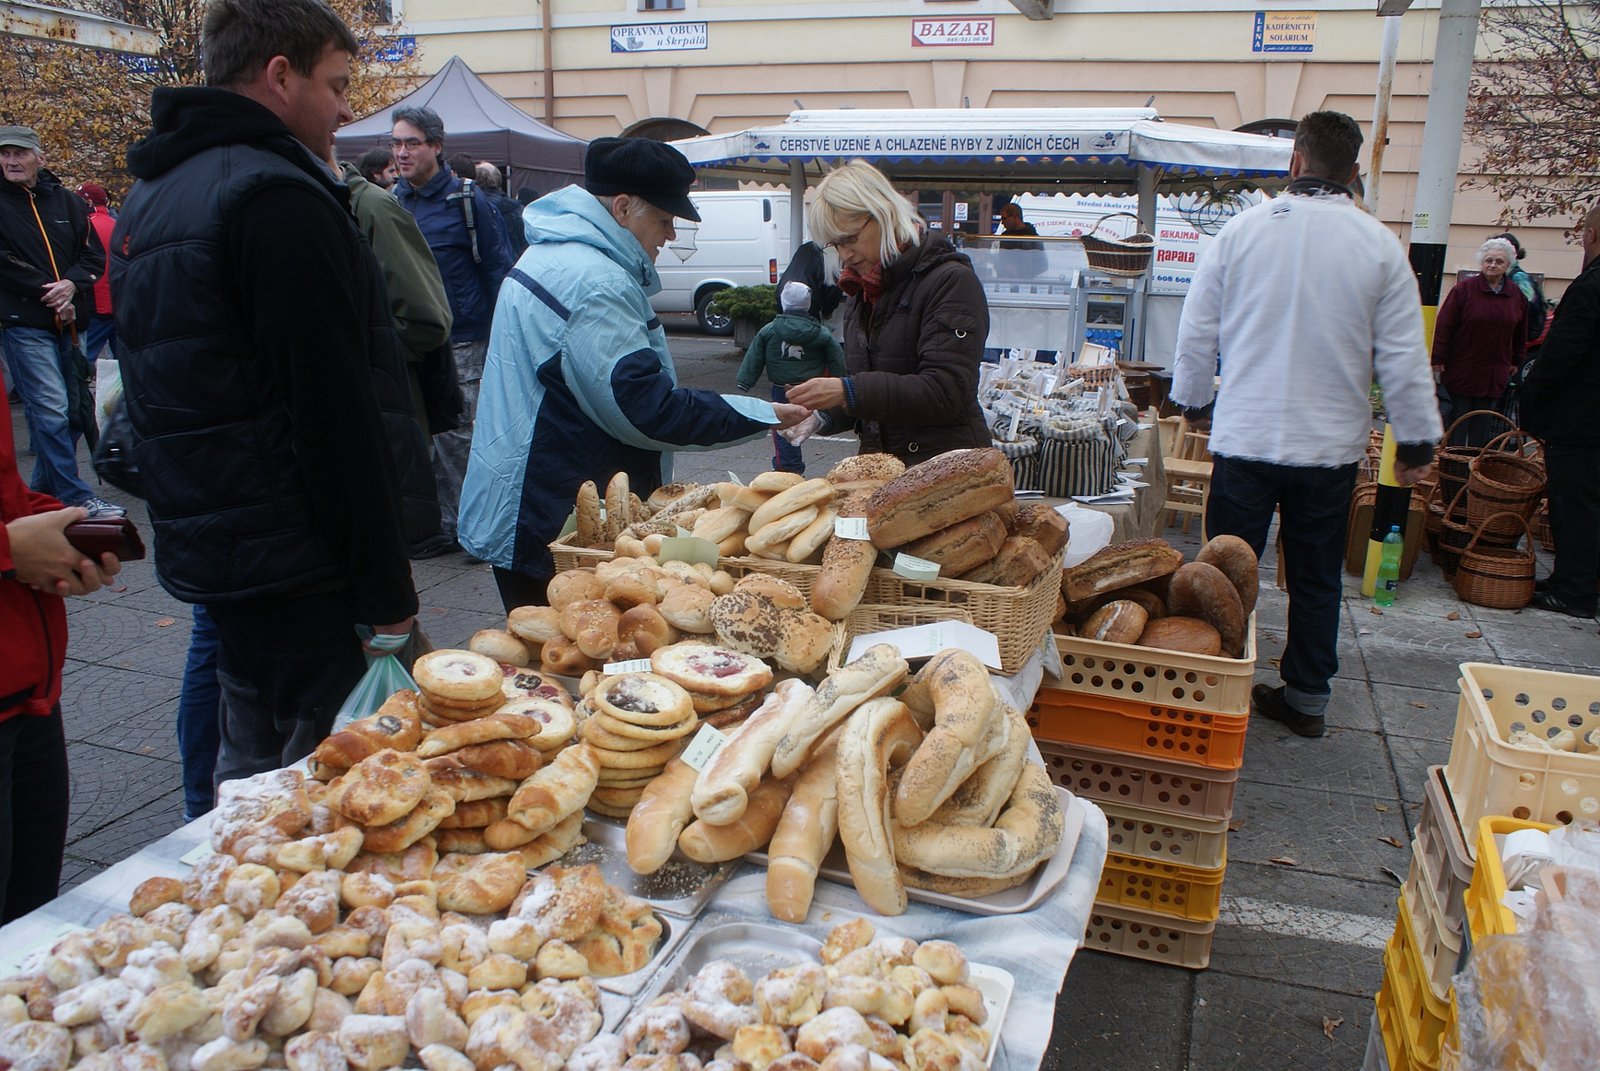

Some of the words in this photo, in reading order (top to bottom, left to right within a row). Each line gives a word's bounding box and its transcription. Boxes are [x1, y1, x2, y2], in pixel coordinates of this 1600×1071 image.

[613, 25, 664, 37] OPRAVNÁ
[670, 24, 705, 35] OBUVI
[919, 22, 989, 36] BAZAR
[1254, 18, 1263, 47] LENA
[1266, 22, 1315, 31] KADEŘNICTVÍ
[1270, 33, 1308, 41] SOLÁRIUM
[780, 136, 830, 151] ČERSTVÉ
[834, 135, 870, 151] UZENÉ
[874, 139, 882, 151] A
[886, 135, 946, 151] CHLAZENÉ
[951, 138, 982, 150] RYBY
[986, 138, 993, 150] Z
[997, 135, 1042, 150] JIŽNÍCH
[1046, 134, 1080, 150] ČECH
[1169, 231, 1199, 240] KAJMAN
